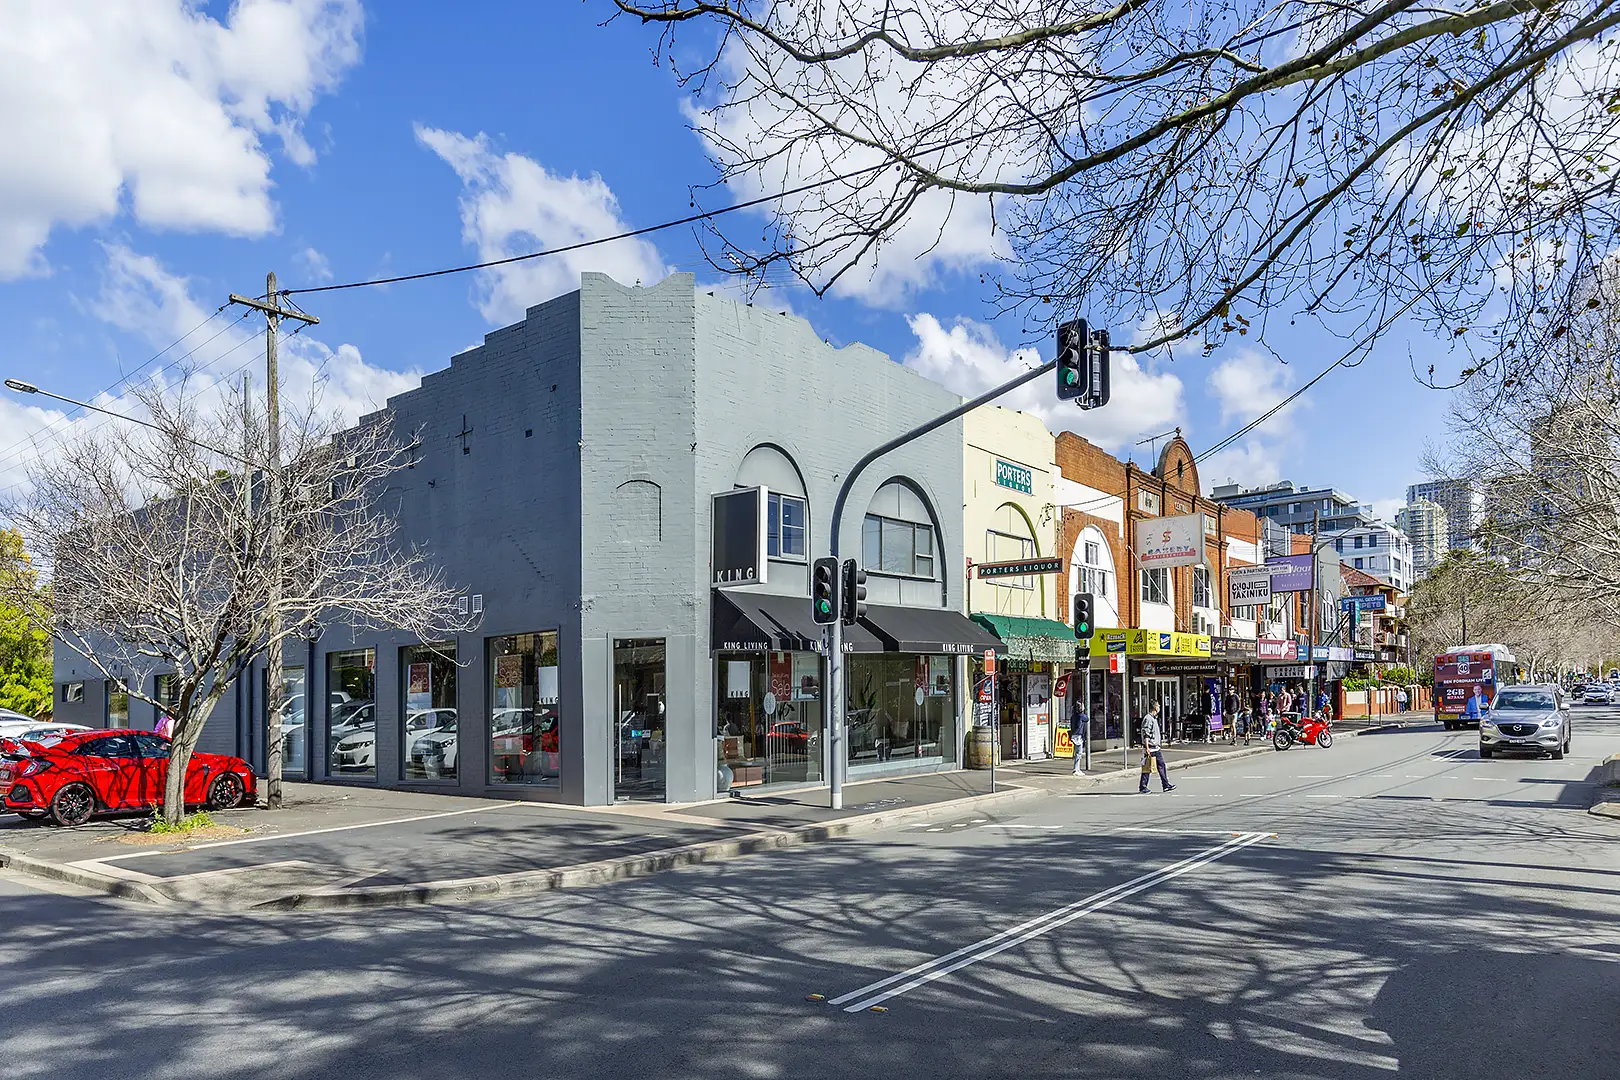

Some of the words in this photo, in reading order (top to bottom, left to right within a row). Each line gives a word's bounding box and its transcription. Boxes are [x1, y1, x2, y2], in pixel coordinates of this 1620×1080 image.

[997, 463, 1031, 486] PORTERS
[980, 566, 1020, 574] PORTERS
[1023, 563, 1059, 571] LIQUOR
[716, 567, 754, 583] KING
[1231, 581, 1254, 592] CHOJI
[1232, 589, 1268, 600] YAKINIKU
[723, 641, 741, 650] KING
[743, 641, 768, 650] LIVING
[942, 643, 956, 652] KING
[957, 644, 974, 653] LIVING
[770, 678, 791, 697] Sale
[1446, 688, 1465, 696] 2GB
[1057, 731, 1073, 748] ICE
